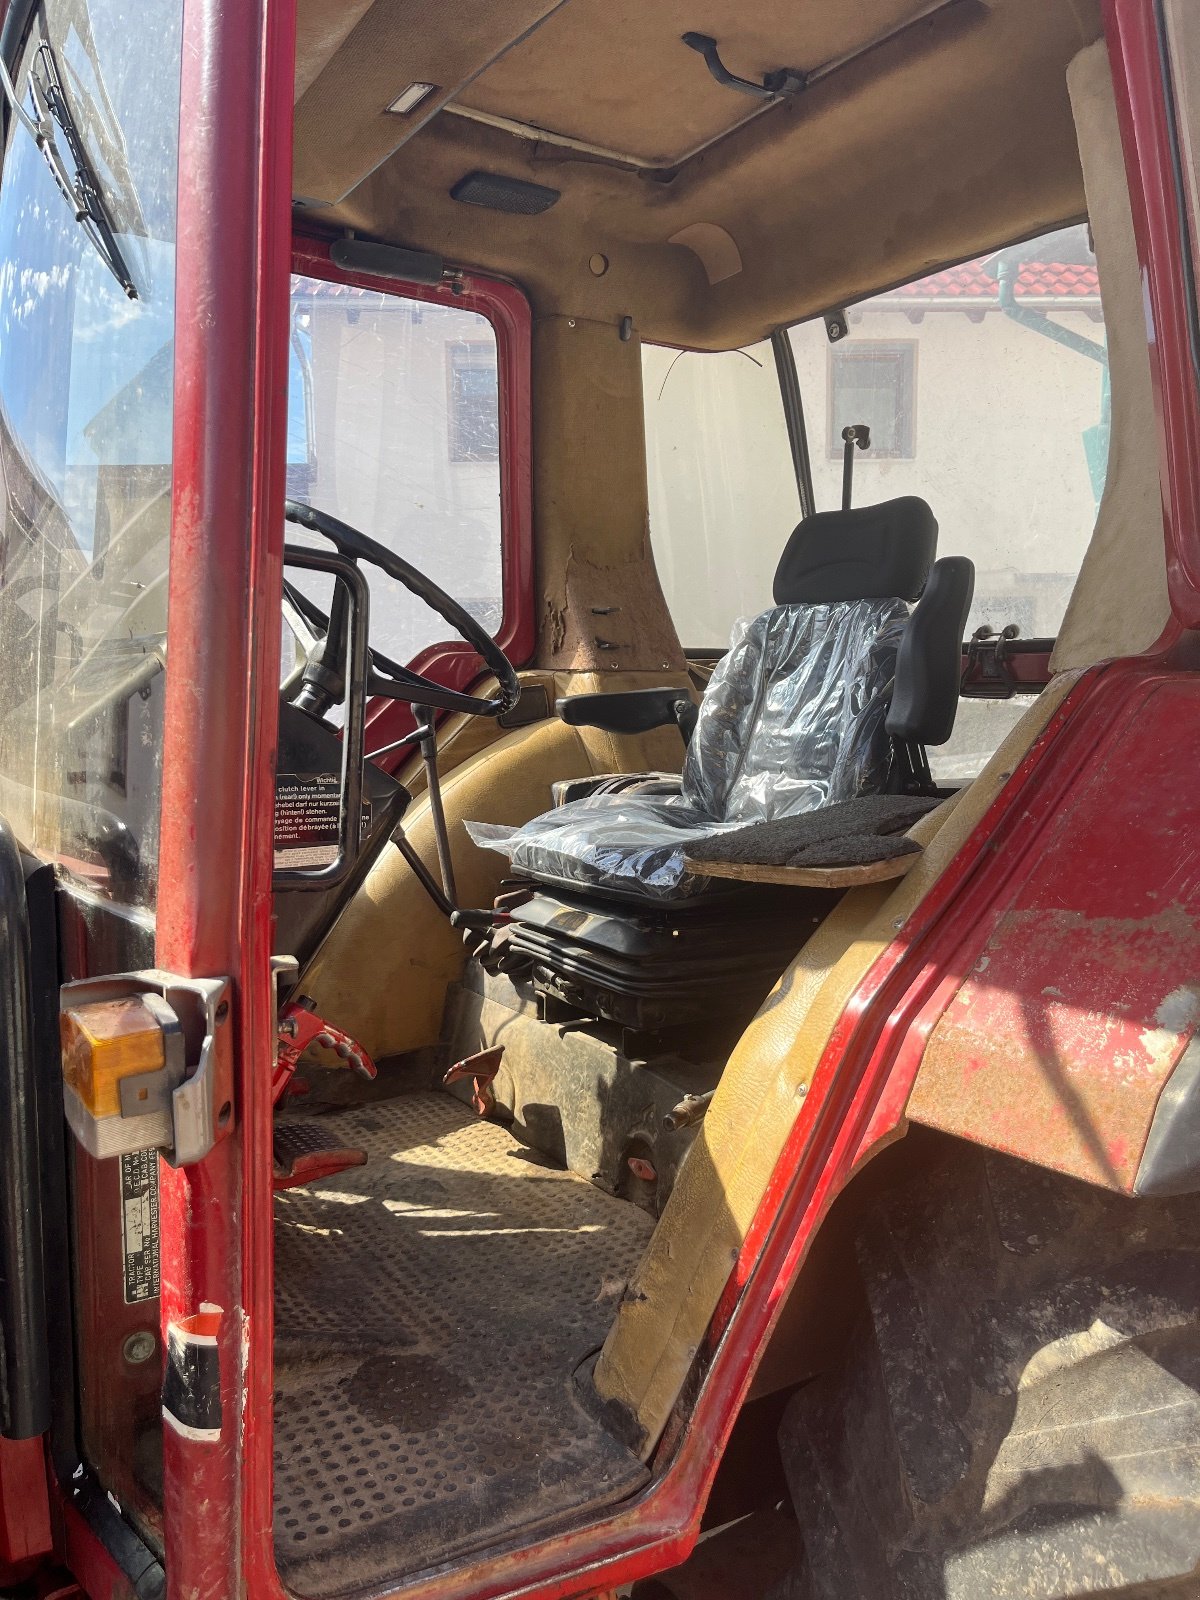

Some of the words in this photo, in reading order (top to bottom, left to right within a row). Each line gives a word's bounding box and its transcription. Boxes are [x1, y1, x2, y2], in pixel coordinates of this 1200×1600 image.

[125, 1163, 132, 1173] OF
[149, 1162, 157, 1196] COMPANY
[150, 1197, 159, 1238] HARVESTER
[127, 1253, 136, 1286] TRACTOR
[136, 1264, 144, 1284] TYPE
[144, 1266, 152, 1281] CAB
[152, 1239, 160, 1294] INTERNATIONAL
